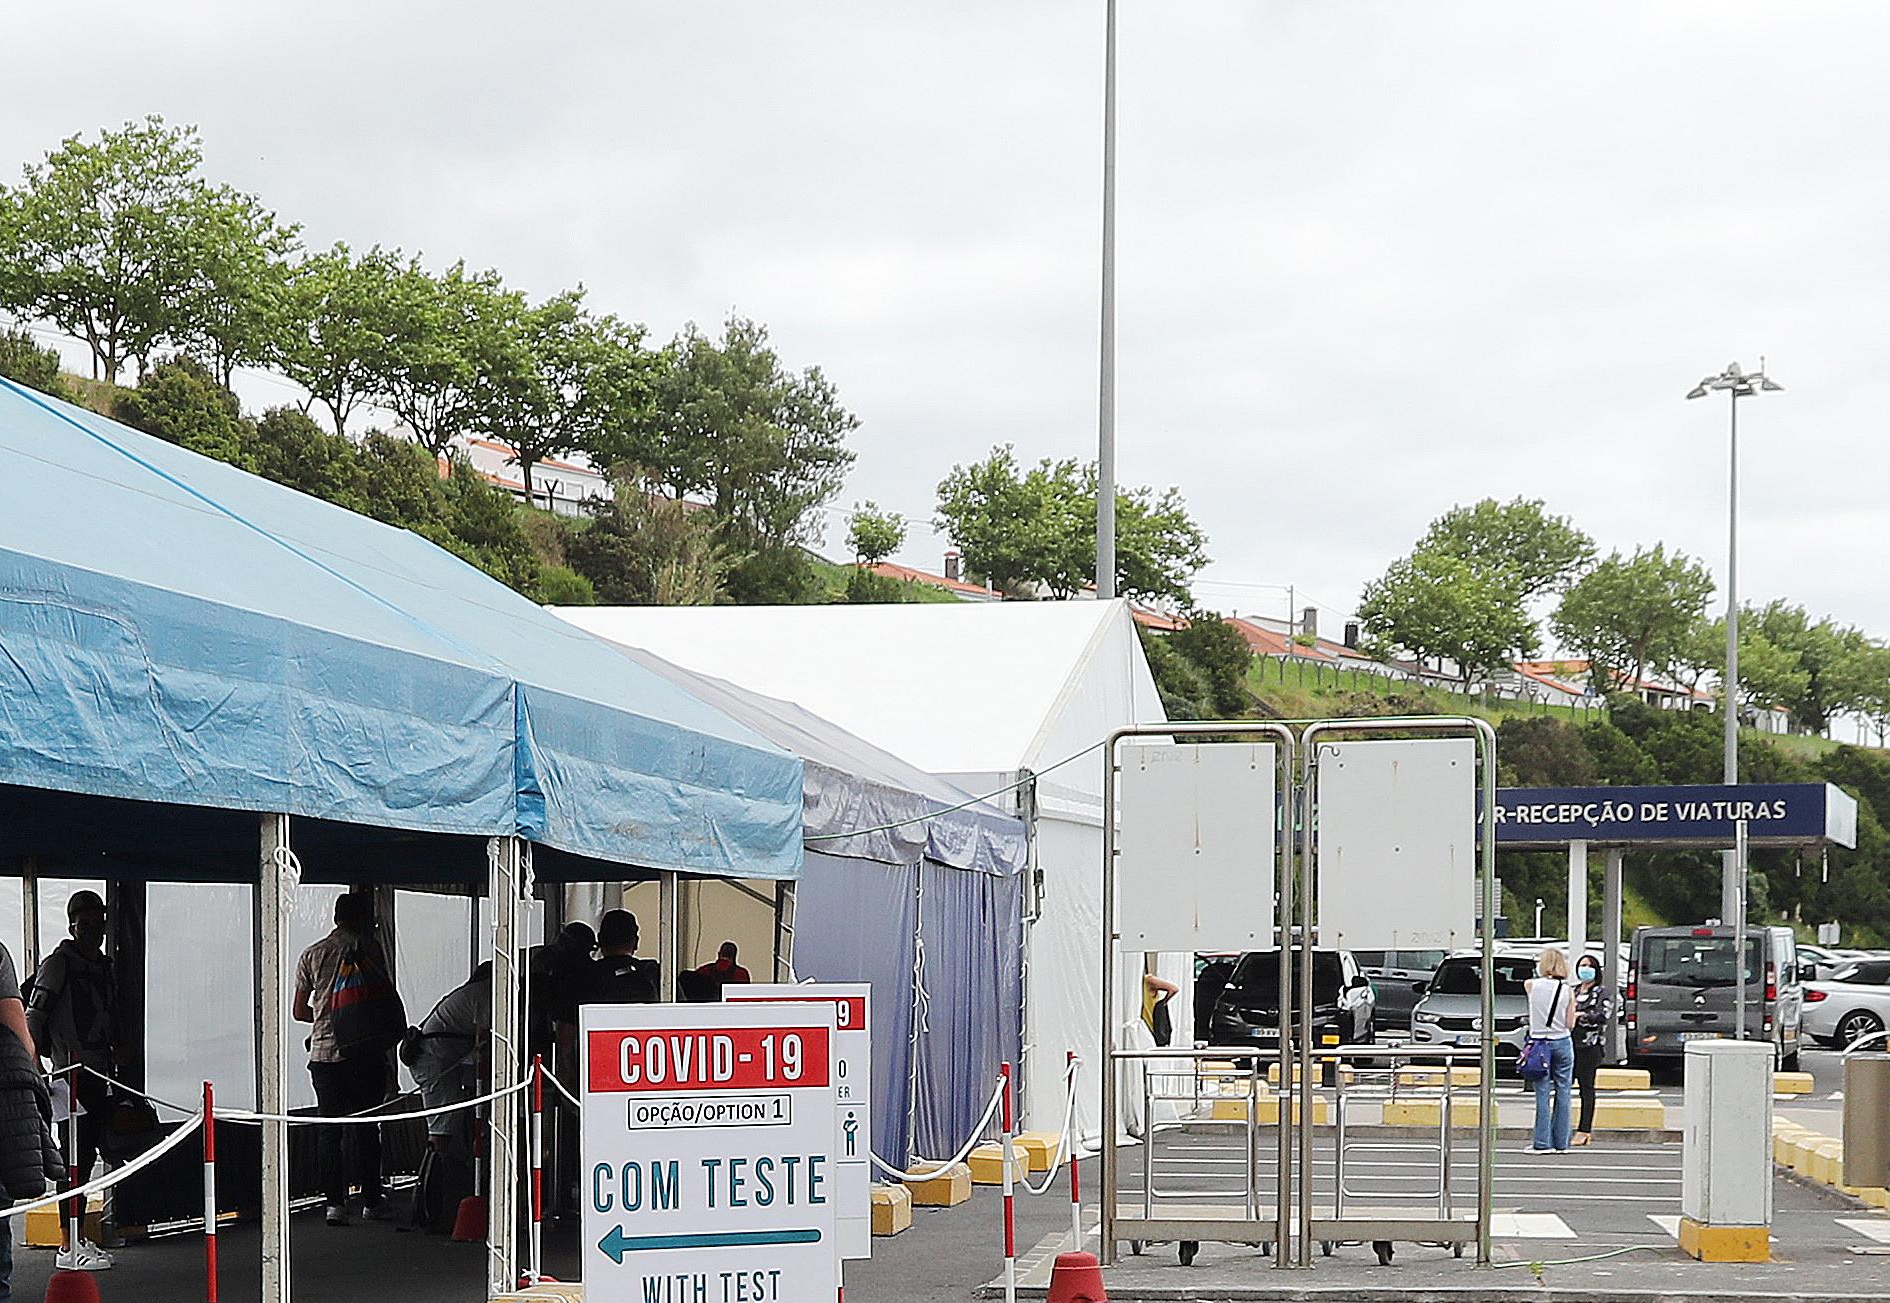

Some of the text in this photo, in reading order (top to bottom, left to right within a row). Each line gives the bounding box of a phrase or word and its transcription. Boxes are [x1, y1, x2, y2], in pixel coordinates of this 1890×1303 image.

[1477, 800, 1787, 828] R-RECEPÇÃO DE VIATURAS
[619, 1033, 804, 1085] COVID-19
[636, 1098, 785, 1126] OPÇÃO/OPTION 1
[593, 1154, 827, 1213] COM TESTE
[719, 1269, 781, 1303] TEST
